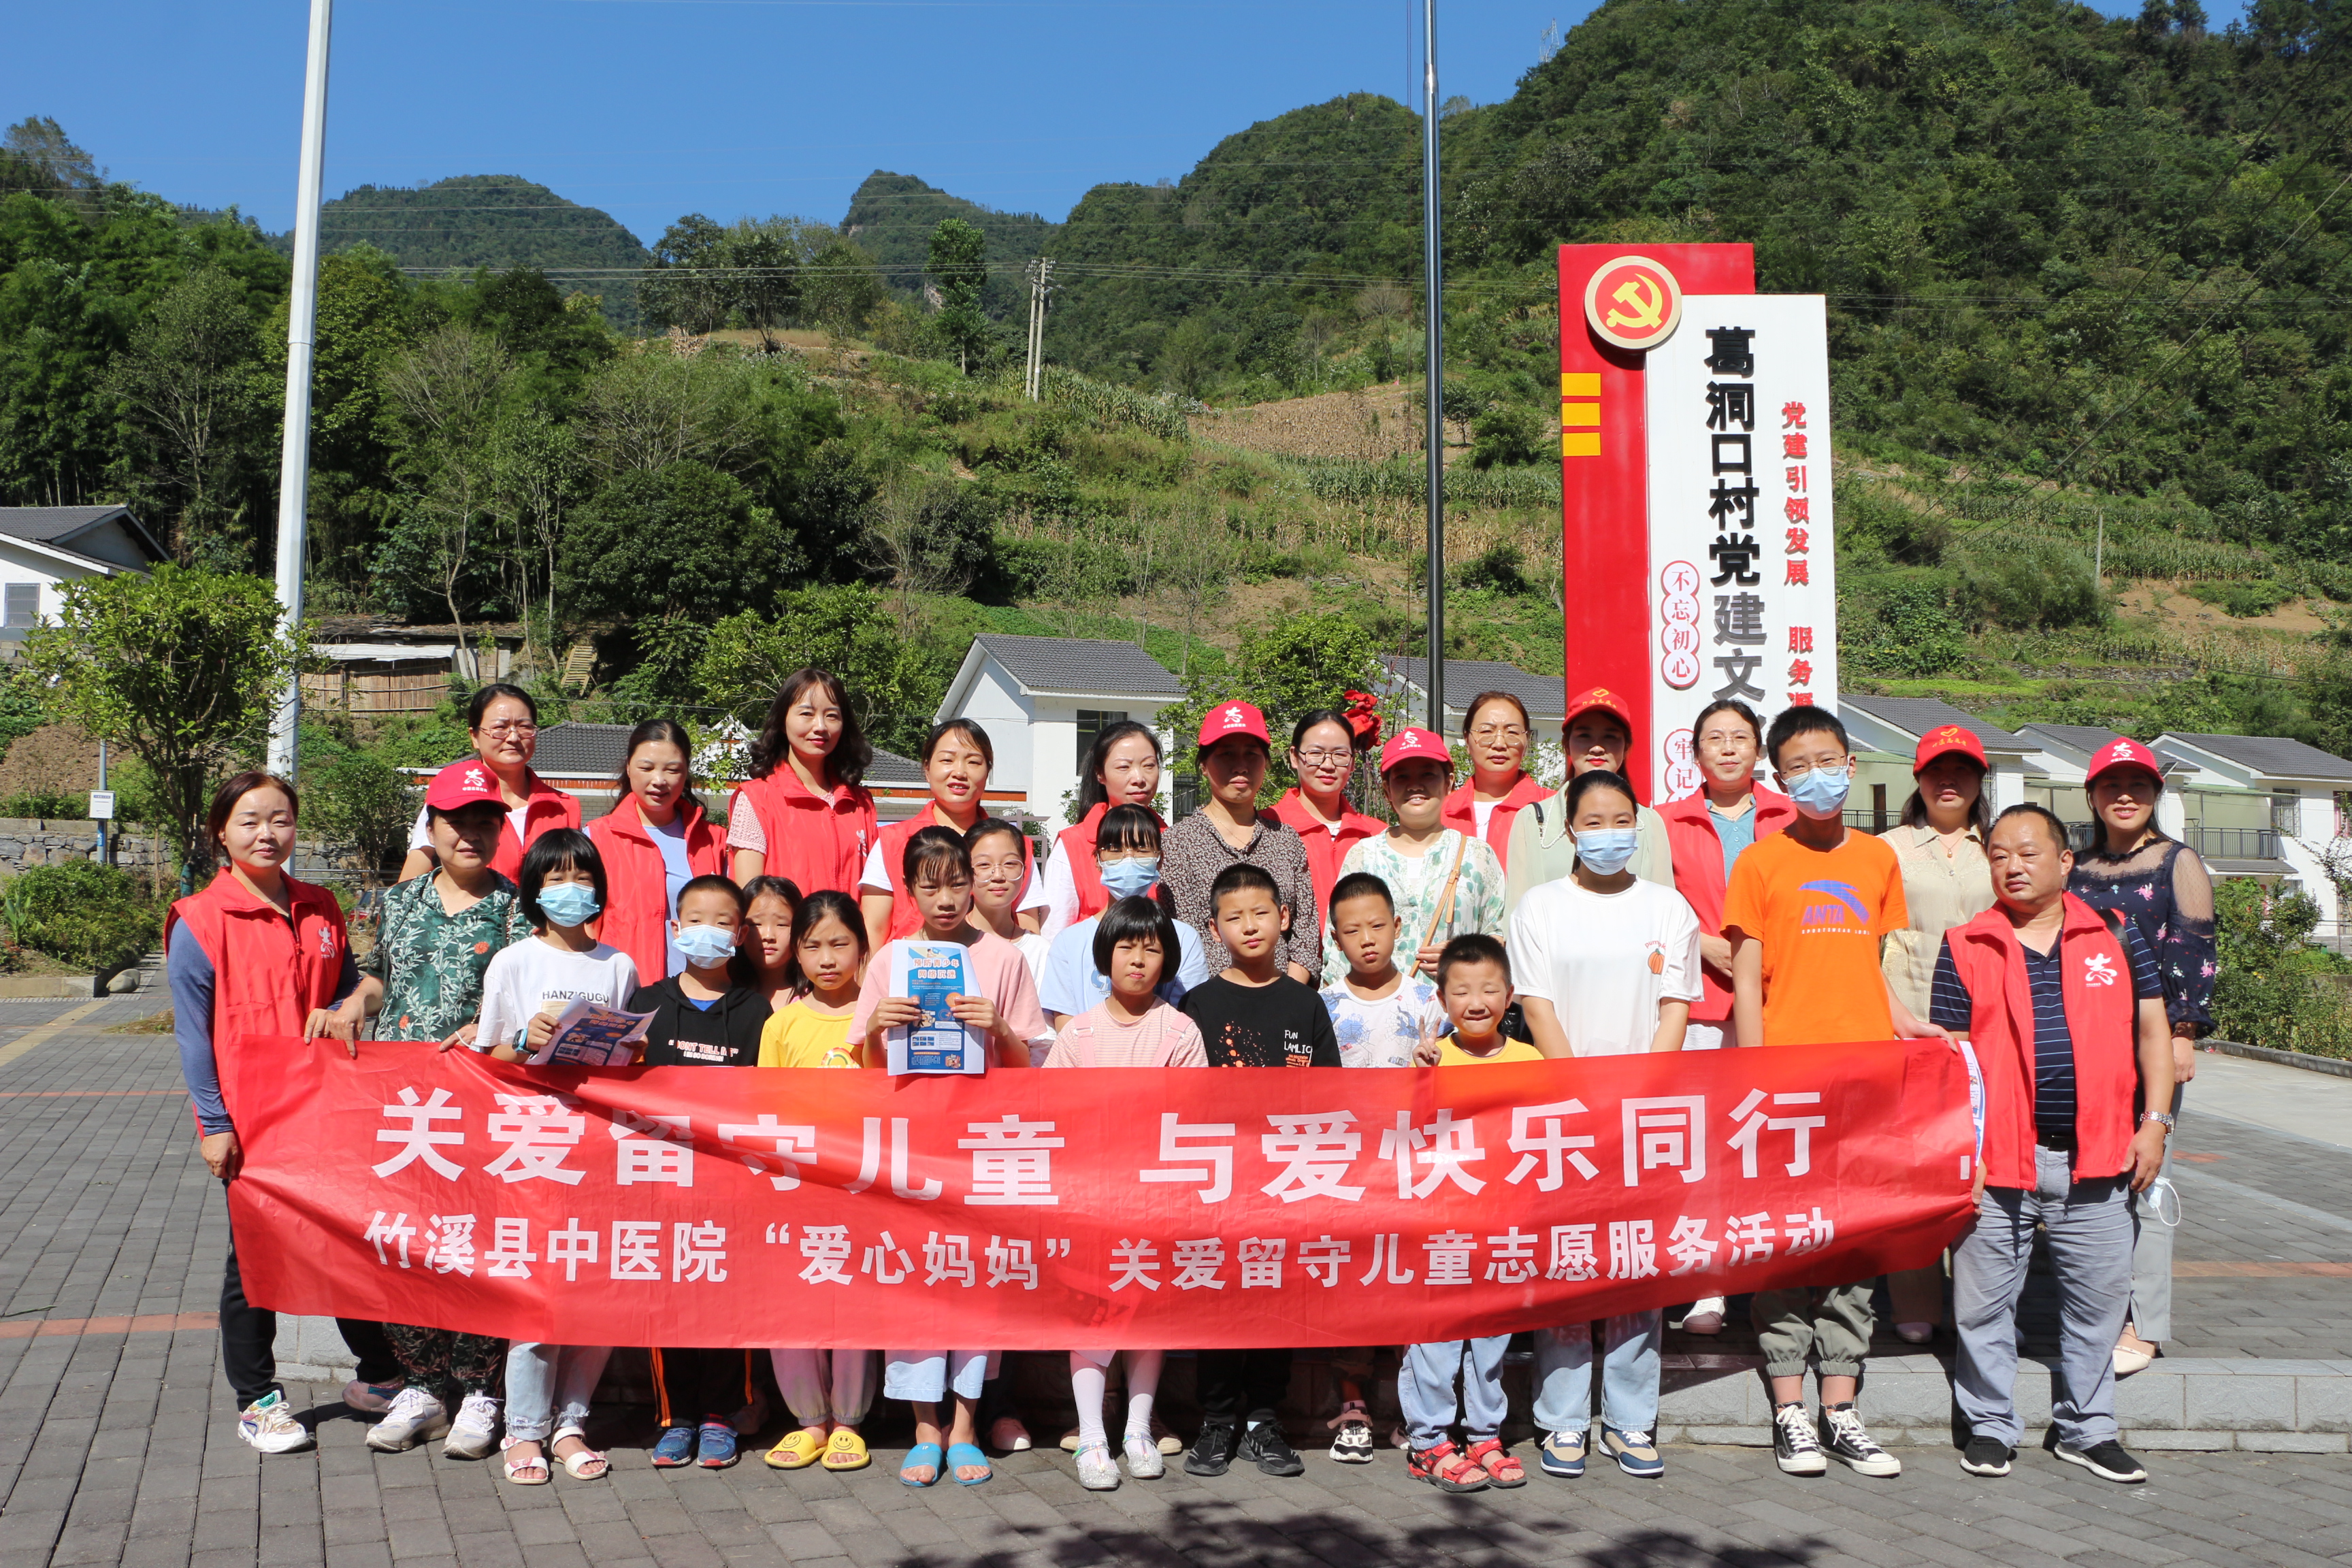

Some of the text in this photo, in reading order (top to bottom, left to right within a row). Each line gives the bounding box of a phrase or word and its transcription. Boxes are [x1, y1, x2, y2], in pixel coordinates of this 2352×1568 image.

[1782, 402, 1810, 586] 党建引领发展
[1703, 326, 1768, 781] 葛洞口村党建文
[1671, 570, 1690, 678] 不忘初心
[1674, 738, 1694, 802] 牢记
[1801, 904, 1845, 926] ANTA
[913, 958, 960, 968] 预防青少年
[918, 969, 956, 979] 网络沉迷
[542, 990, 609, 1003] HANZGUGU
[1284, 1030, 1298, 1040] FUN
[698, 1043, 719, 1055] TELL
[371, 1086, 1826, 1205] 关爱留守儿童 与爱快乐同行
